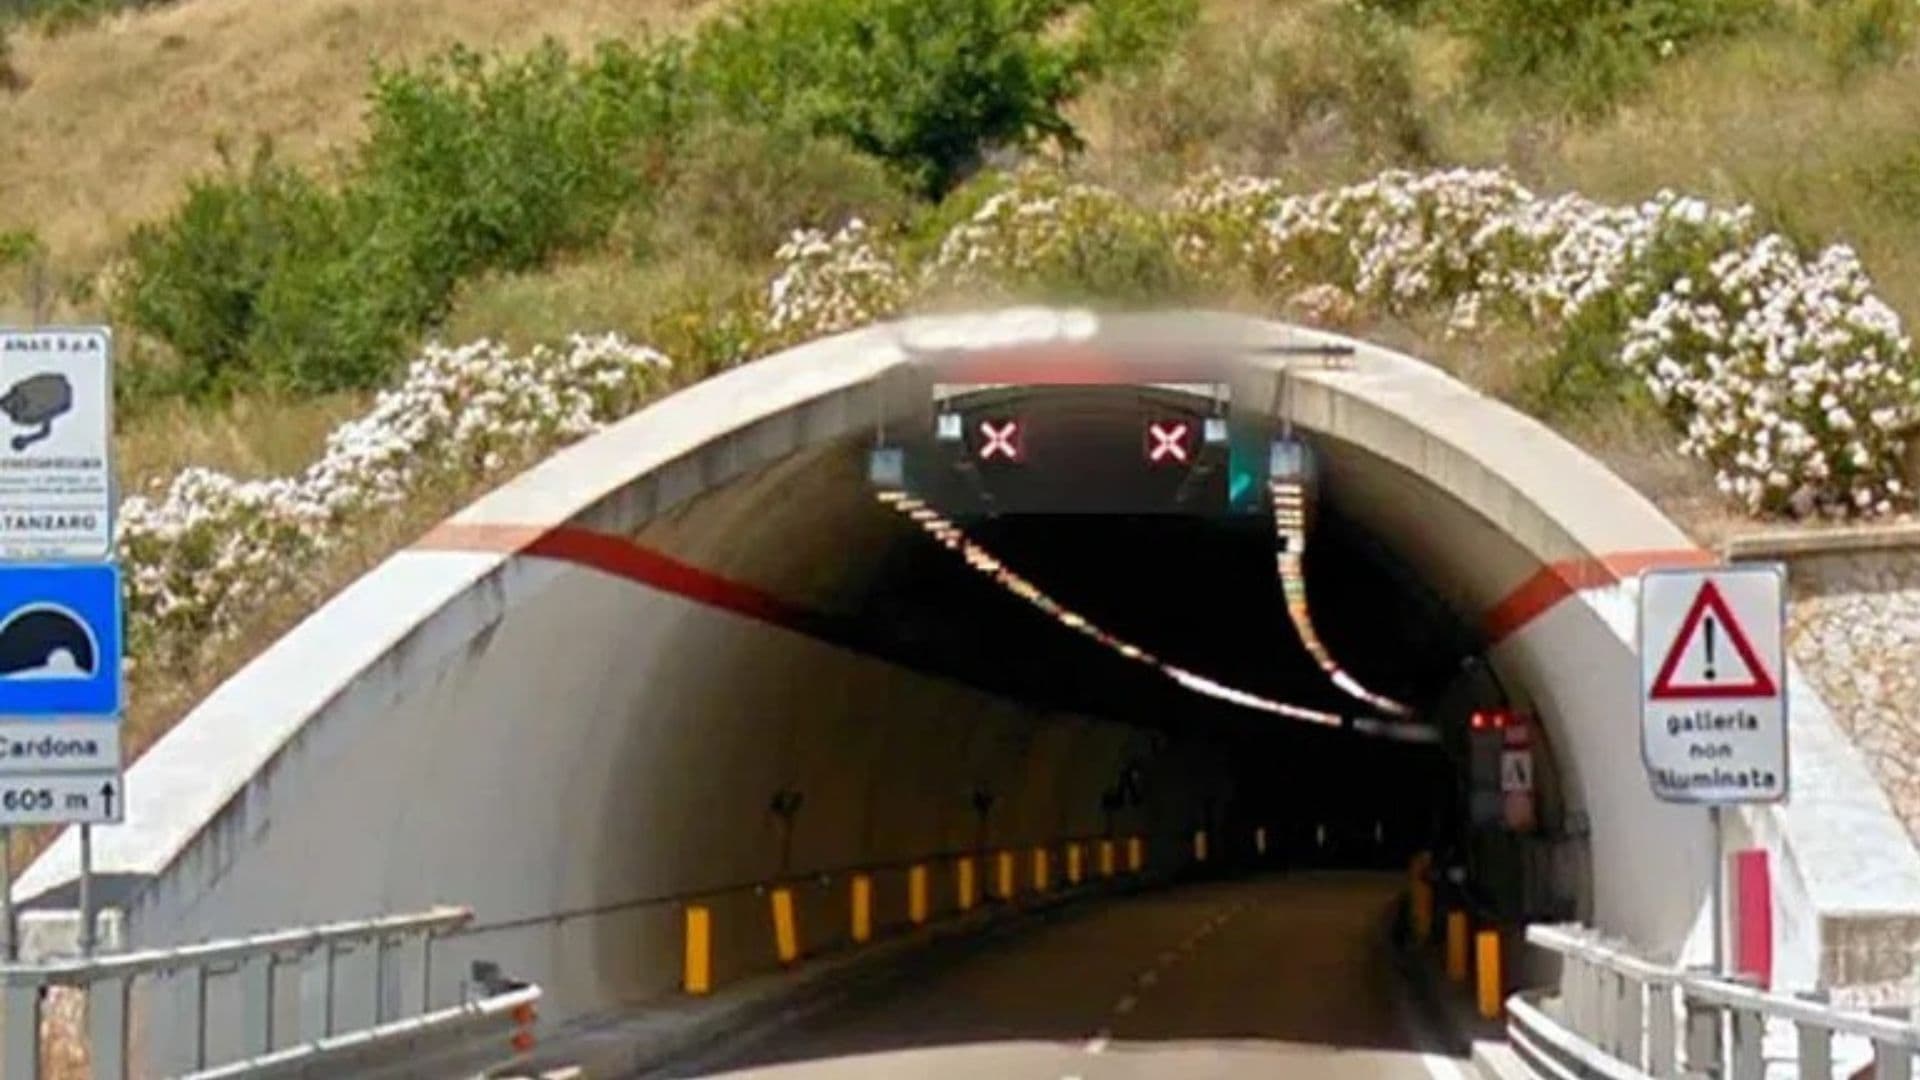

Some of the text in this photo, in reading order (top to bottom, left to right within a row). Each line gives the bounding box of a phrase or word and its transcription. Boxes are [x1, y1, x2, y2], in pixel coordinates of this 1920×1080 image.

[0, 515, 97, 531] TANZARO
[1667, 710, 1758, 736] galleria
[1689, 744, 1732, 759] non
[3, 789, 89, 811] 605 m
